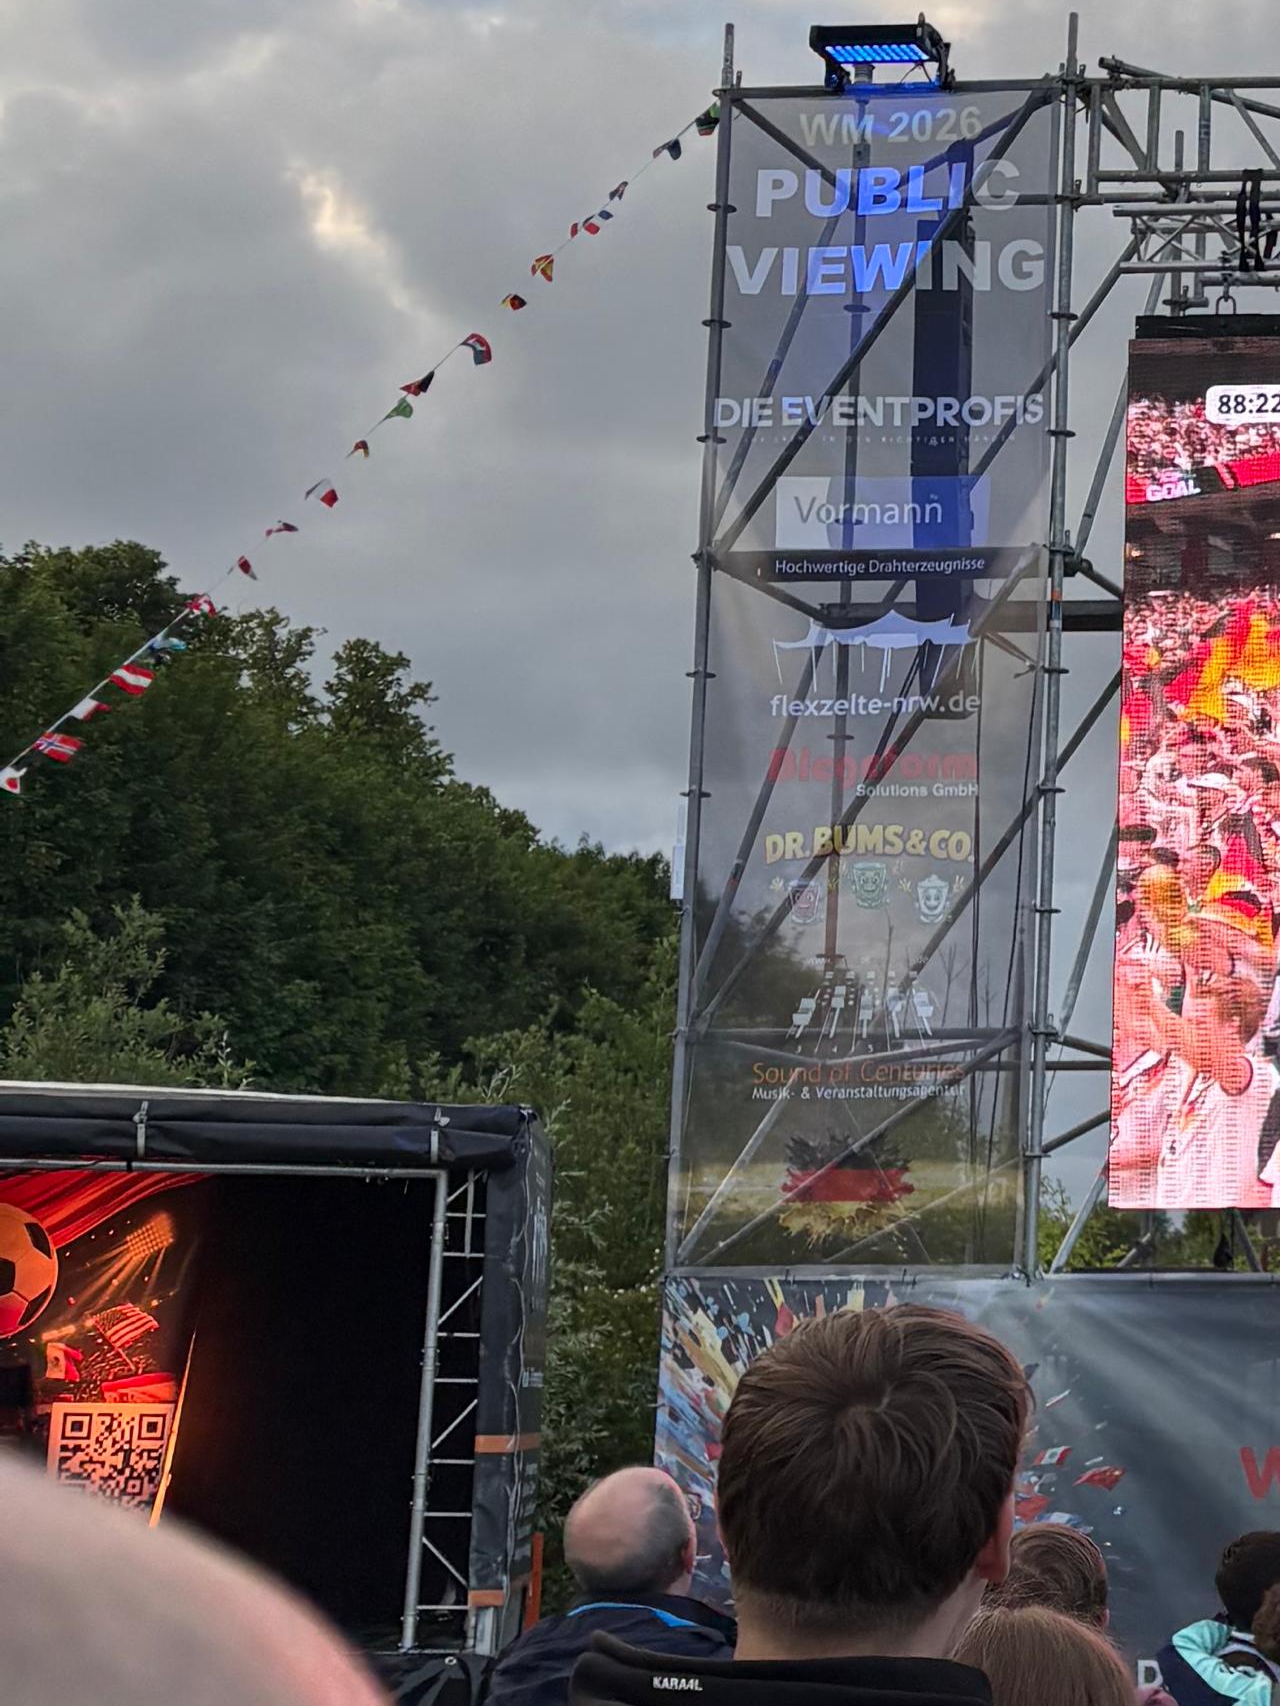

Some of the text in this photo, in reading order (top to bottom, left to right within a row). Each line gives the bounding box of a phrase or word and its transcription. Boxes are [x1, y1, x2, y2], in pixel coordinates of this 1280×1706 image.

[801, 106, 983, 147] WM 2026
[756, 159, 1020, 217] PUBLIC
[725, 239, 1045, 295] VIEWING
[713, 393, 1044, 428] DIE EVENTPROFIS
[1145, 480, 1201, 502] GOAL
[794, 496, 943, 524] Vormann
[775, 557, 985, 576] Hochwertige Drahterzeugnisse
[771, 690, 981, 717] flexzelte-nrw.de
[856, 783, 979, 797] Solutions GmbH
[752, 1061, 822, 1085] Sound
[861, 1060, 966, 1083] Centuries
[801, 1086, 811, 1099] &
[816, 1085, 966, 1101] Veranstaltungsagentur
